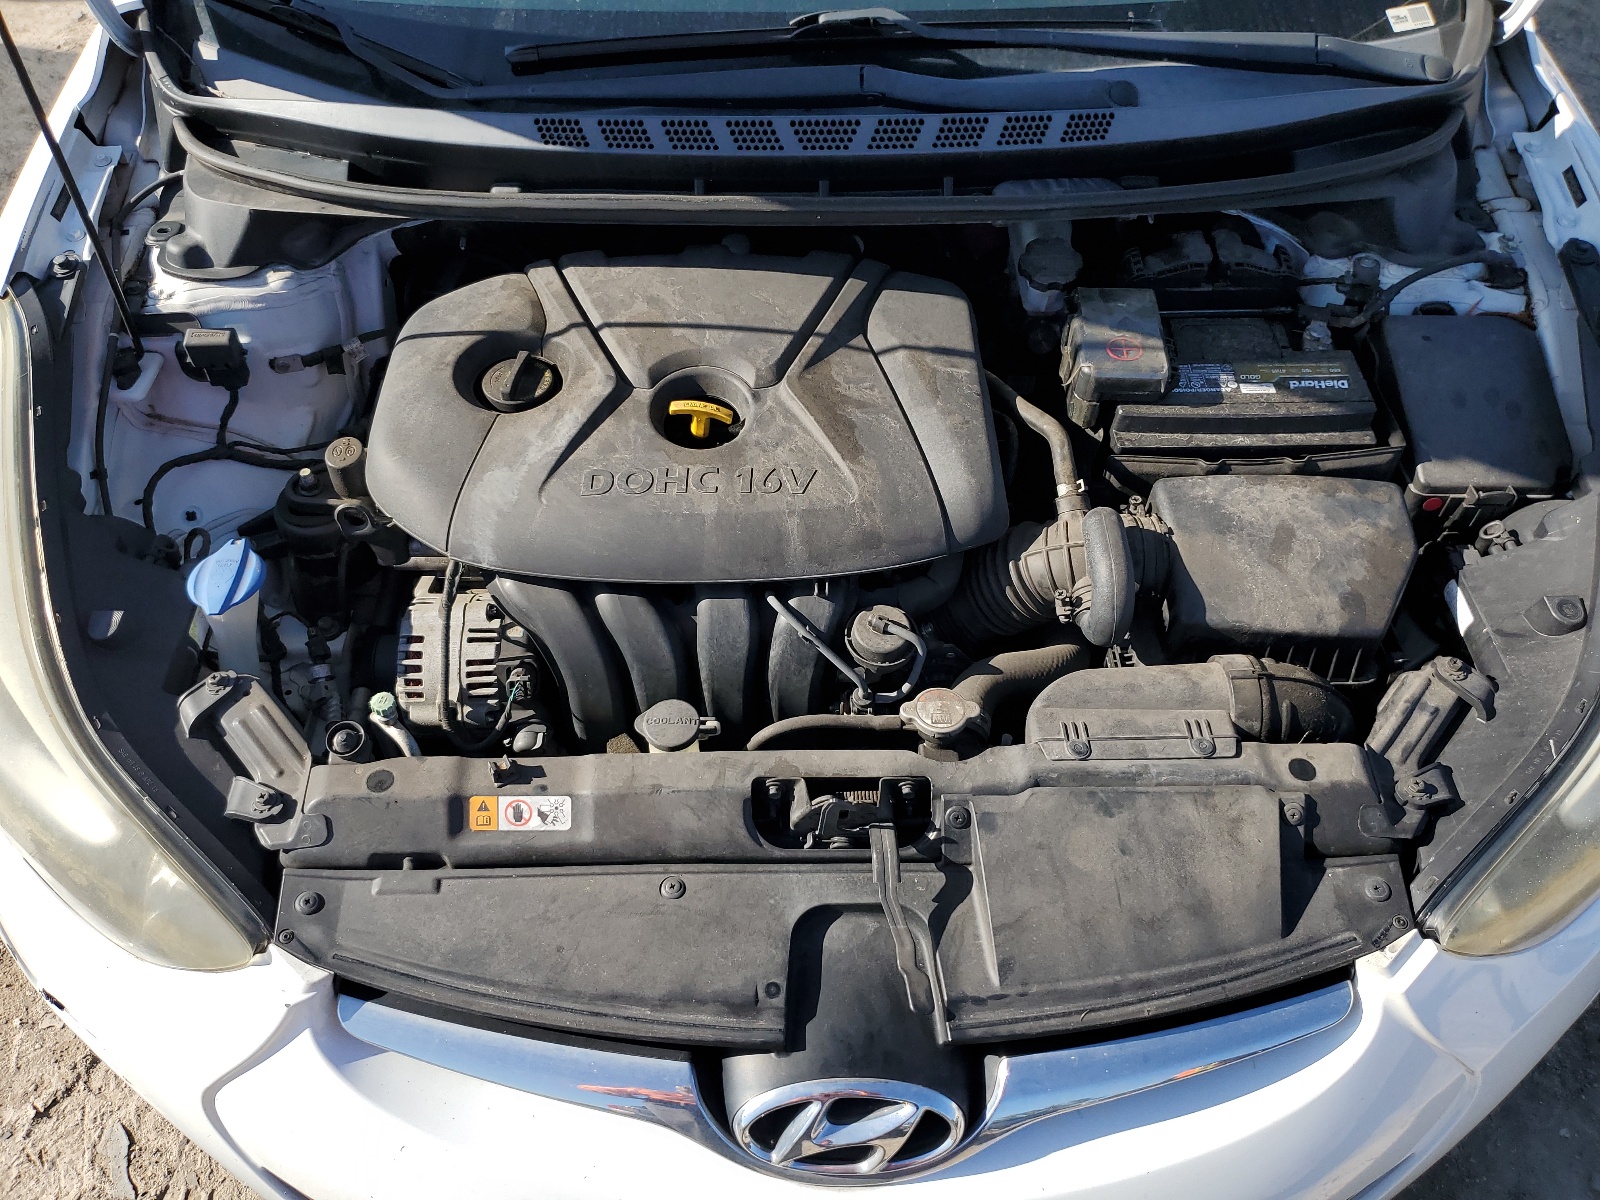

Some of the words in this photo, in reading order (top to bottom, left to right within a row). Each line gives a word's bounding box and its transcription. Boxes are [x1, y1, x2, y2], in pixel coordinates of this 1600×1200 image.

[1288, 380, 1349, 389] DieHard
[580, 467, 720, 496] DOHC
[735, 467, 819, 495] 16V
[646, 716, 700, 726] COOLANT
